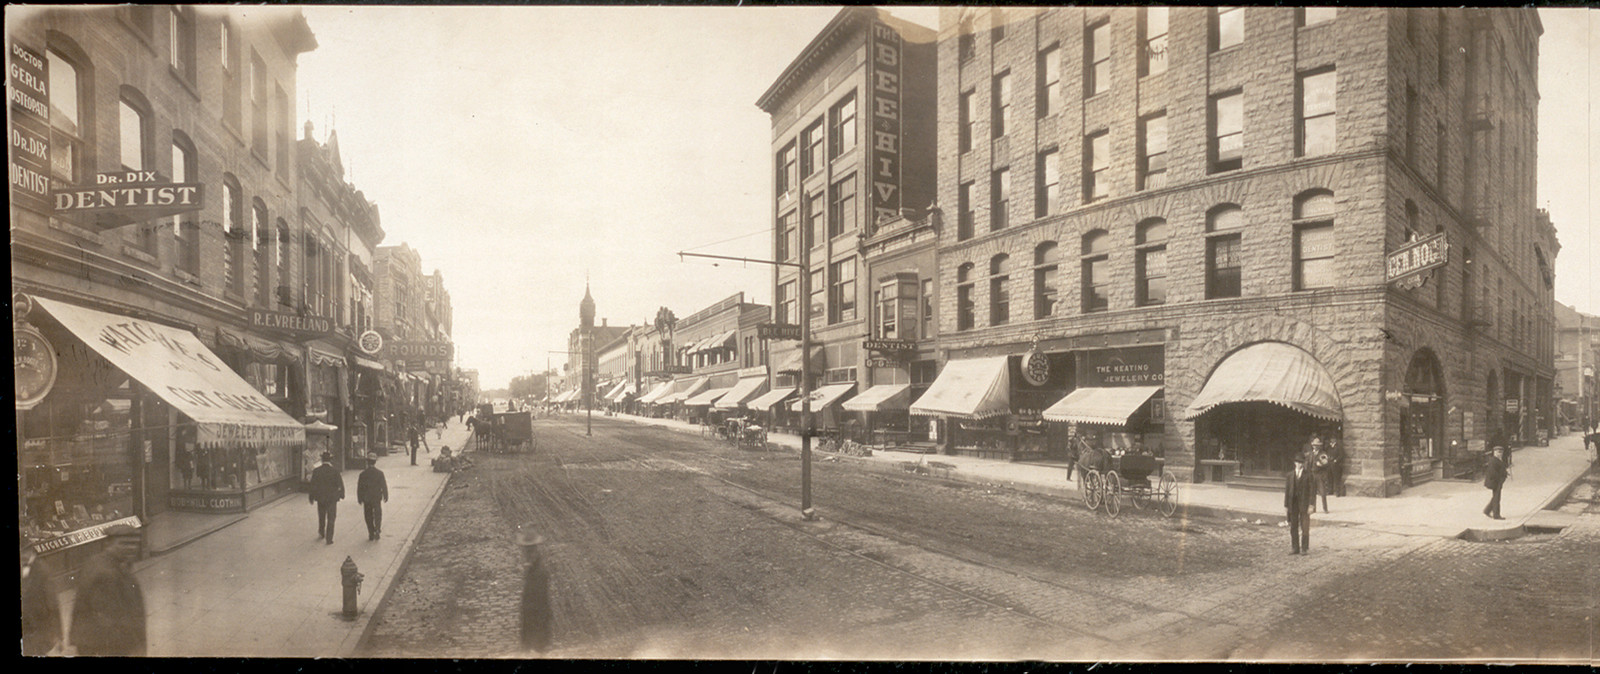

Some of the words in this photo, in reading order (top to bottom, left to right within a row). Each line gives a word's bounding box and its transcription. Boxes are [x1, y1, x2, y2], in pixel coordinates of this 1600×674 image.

[875, 25, 898, 43] THE
[13, 44, 43, 71] DOCTOR
[11, 63, 46, 96] GERLA
[875, 44, 898, 120] BEE
[10, 86, 48, 119] OSTEOPATH
[12, 163, 49, 195] DENTIST
[126, 172, 156, 183] DIX
[874, 131, 897, 223] HIVE
[167, 385, 222, 409] CUT
[217, 426, 258, 439] JEWELER
